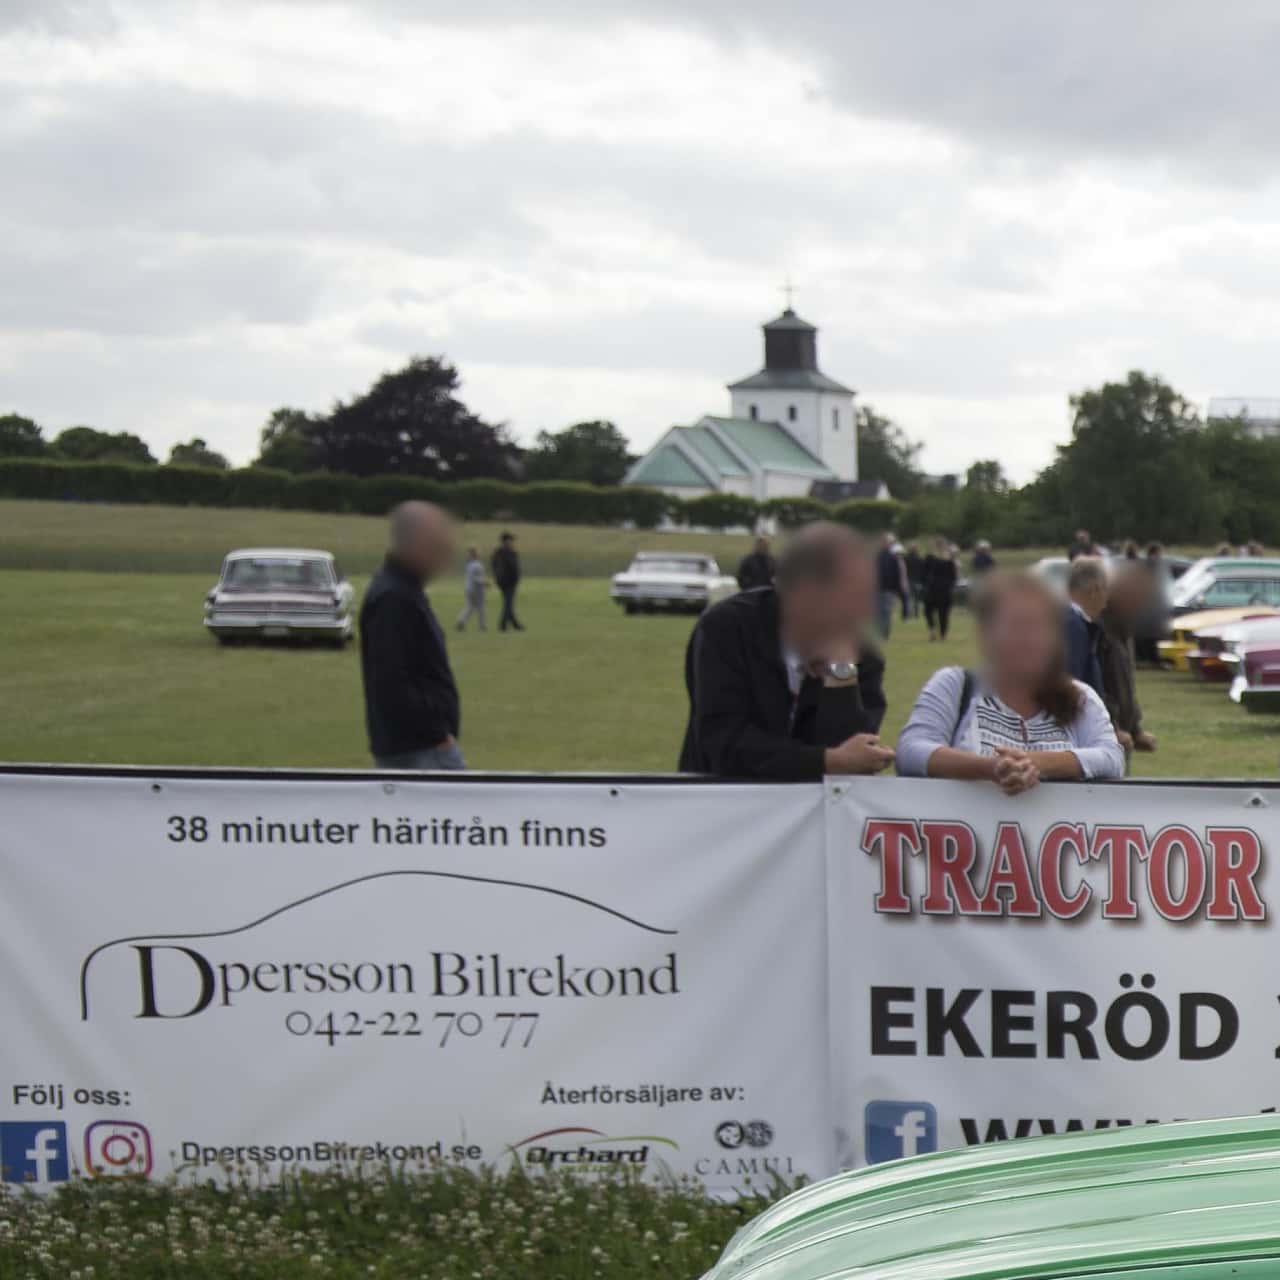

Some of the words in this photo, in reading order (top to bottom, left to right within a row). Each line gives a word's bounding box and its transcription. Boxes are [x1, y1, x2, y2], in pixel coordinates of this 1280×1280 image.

[167, 815, 209, 843] 38
[221, 815, 359, 844] minuter
[372, 815, 508, 847] härifrån
[520, 818, 607, 848] finns
[861, 817, 1268, 922] TRACTOR
[130, 943, 415, 1020] Dpersson
[430, 951, 681, 998] Bilrekond
[285, 1009, 423, 1047] 042-22
[434, 1011, 483, 1048] 70
[494, 1011, 540, 1048] 77
[870, 973, 1240, 1062] EKERÖD
[13, 1083, 63, 1110] Följ
[73, 1088, 131, 1106] oss:
[541, 1081, 703, 1107] Återförsäljare
[709, 1085, 746, 1101] av:
[526, 1145, 649, 1163] Orchard
